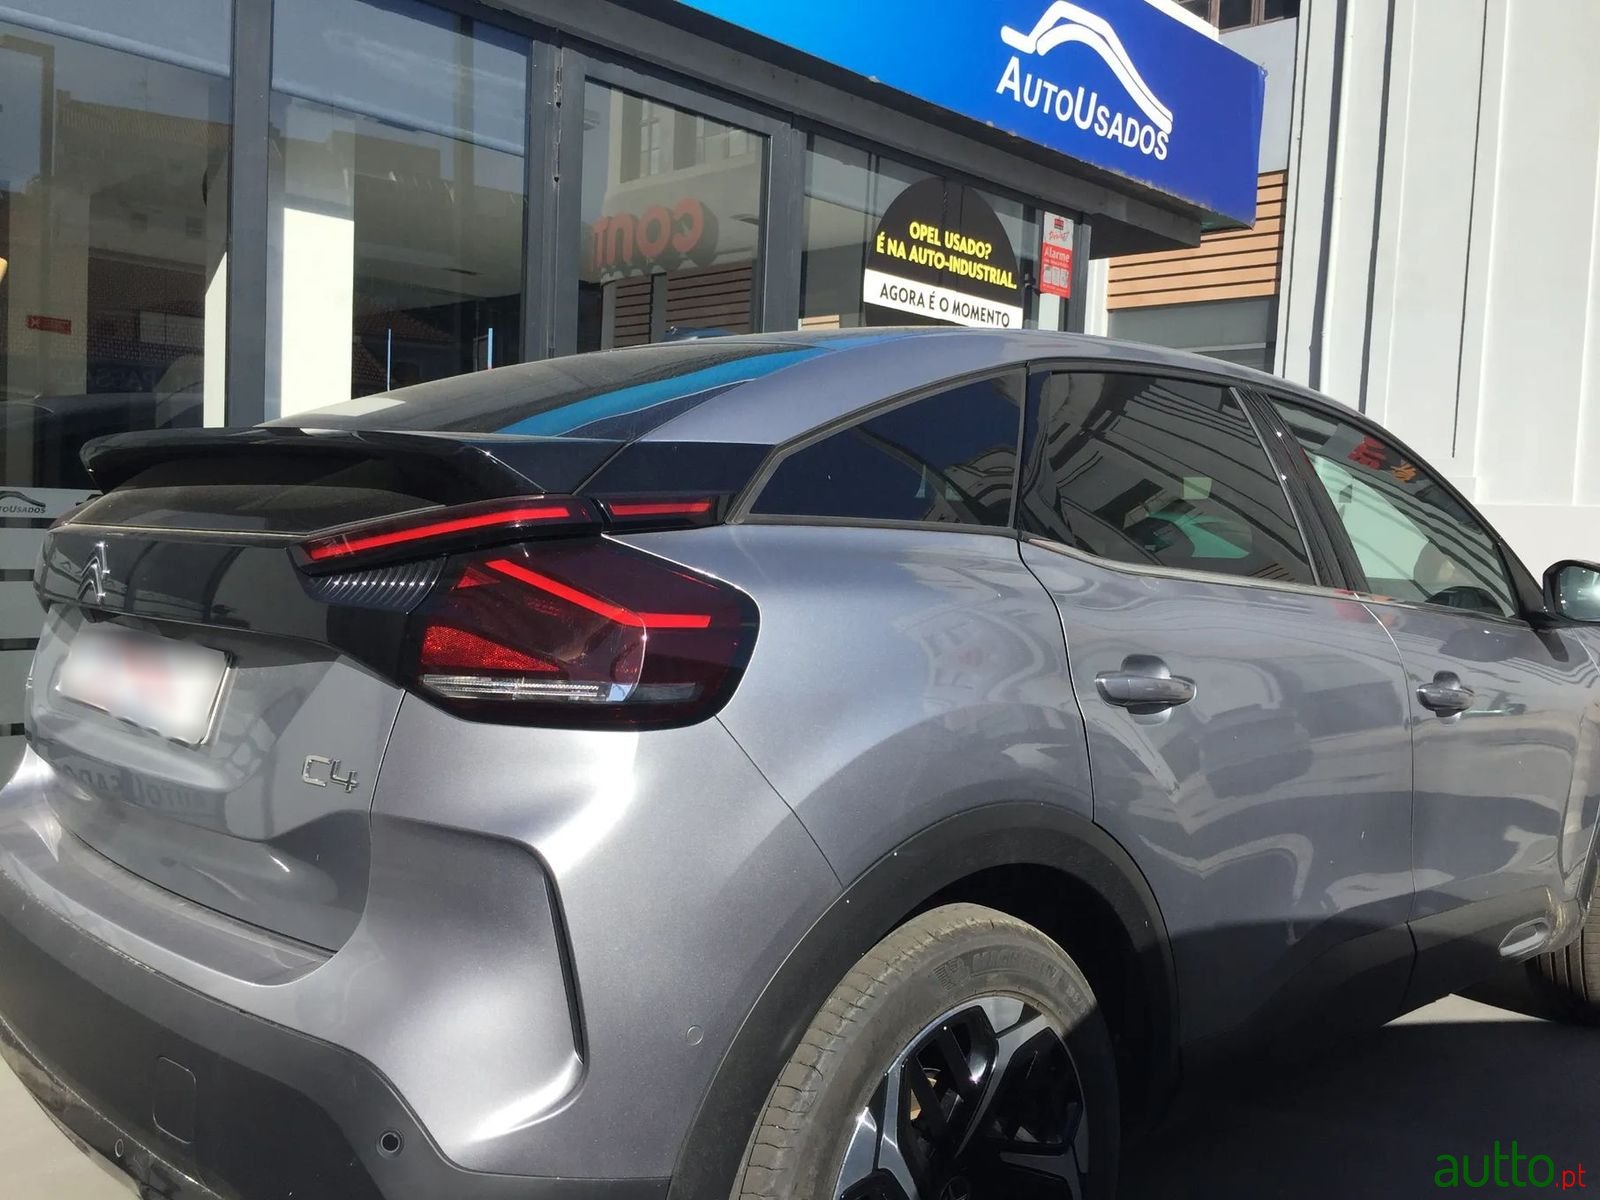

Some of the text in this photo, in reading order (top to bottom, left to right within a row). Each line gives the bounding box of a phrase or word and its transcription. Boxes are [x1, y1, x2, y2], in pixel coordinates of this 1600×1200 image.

[909, 221, 992, 260] OPEL USADO?
[1044, 246, 1070, 263] Alarme
[876, 231, 886, 254] É
[887, 237, 907, 260] NA
[908, 244, 1017, 290] AUTO-INDUSTRIAL.
[880, 282, 1010, 328] AGORA É O MOMENTO
[302, 755, 359, 793] C4
